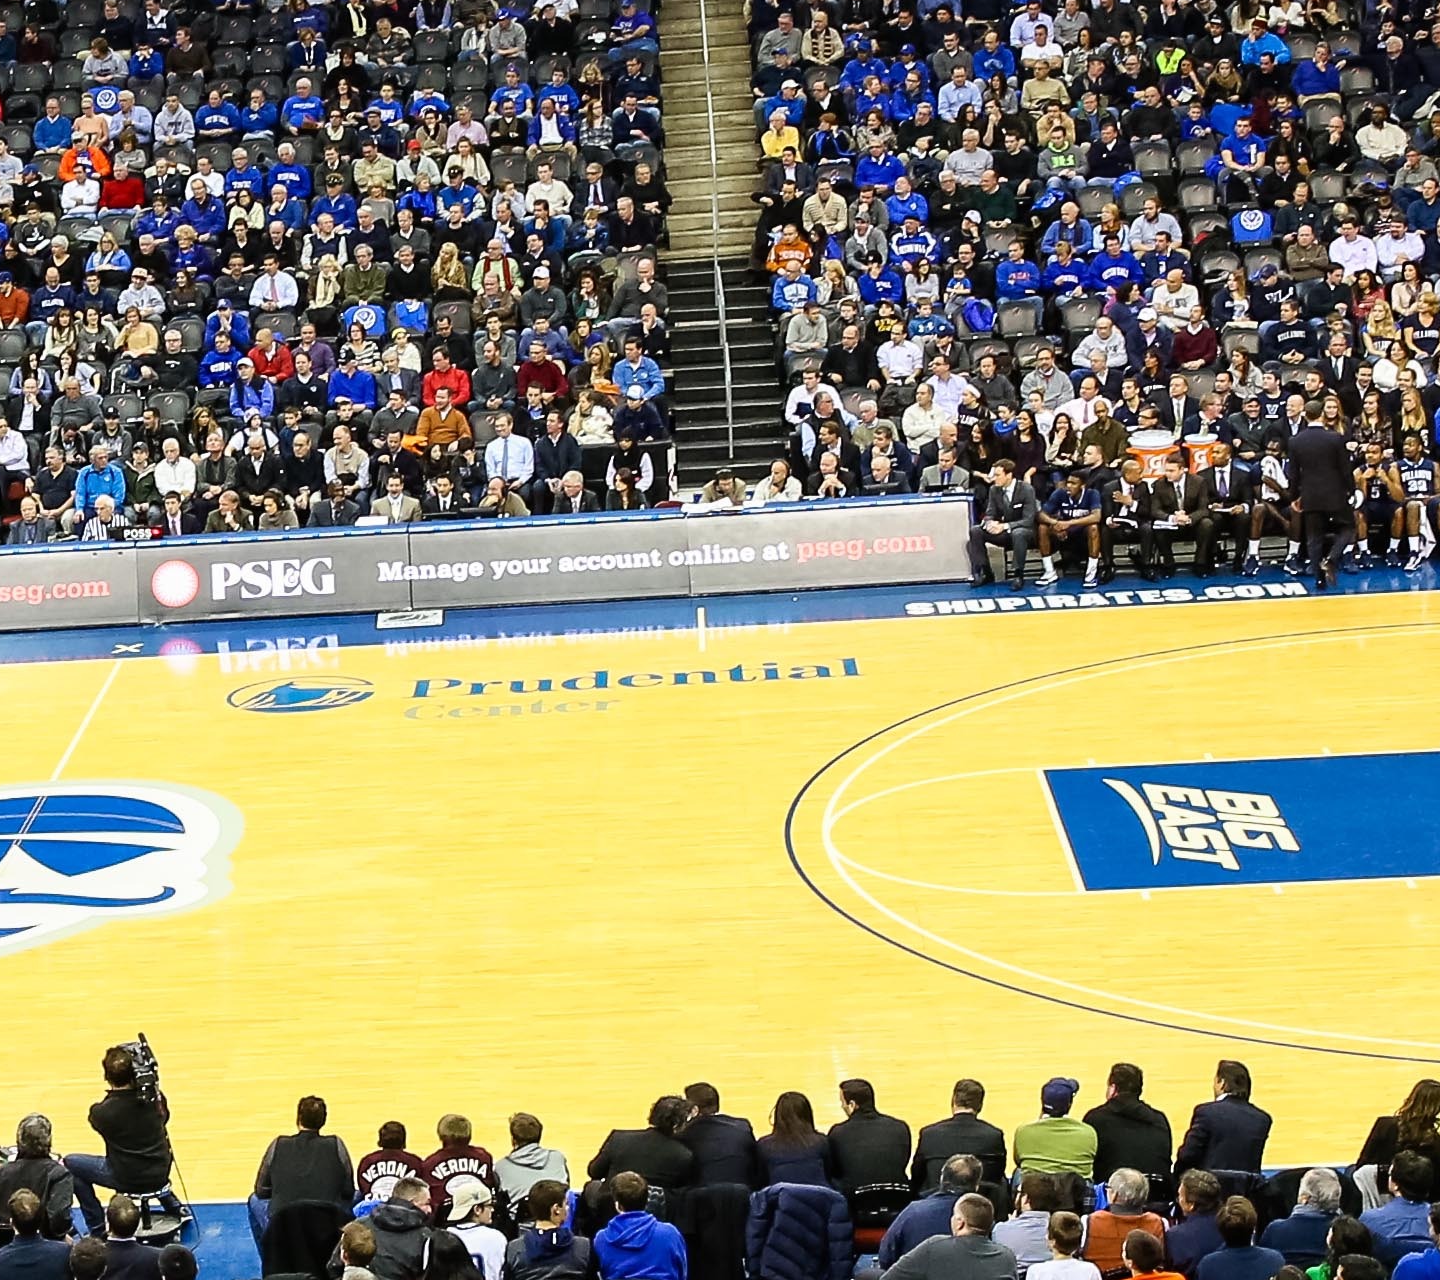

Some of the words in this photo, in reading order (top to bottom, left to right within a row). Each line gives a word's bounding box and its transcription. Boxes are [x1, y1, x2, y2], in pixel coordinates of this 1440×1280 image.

[123, 527, 152, 539] POSS
[378, 558, 484, 581] Manage
[492, 556, 551, 577] your
[559, 550, 662, 571] account
[668, 543, 755, 566] online
[762, 542, 789, 560] at
[797, 534, 933, 561] pseg.com
[905, 579, 1307, 615] SHUPIRATES.COM
[408, 657, 861, 698] Prudential
[404, 695, 622, 721] Center
[1141, 782, 1240, 870] EAST
[1206, 789, 1300, 852] BIG
[362, 1160, 417, 1184] VERONA
[432, 1157, 488, 1181] VERONA
